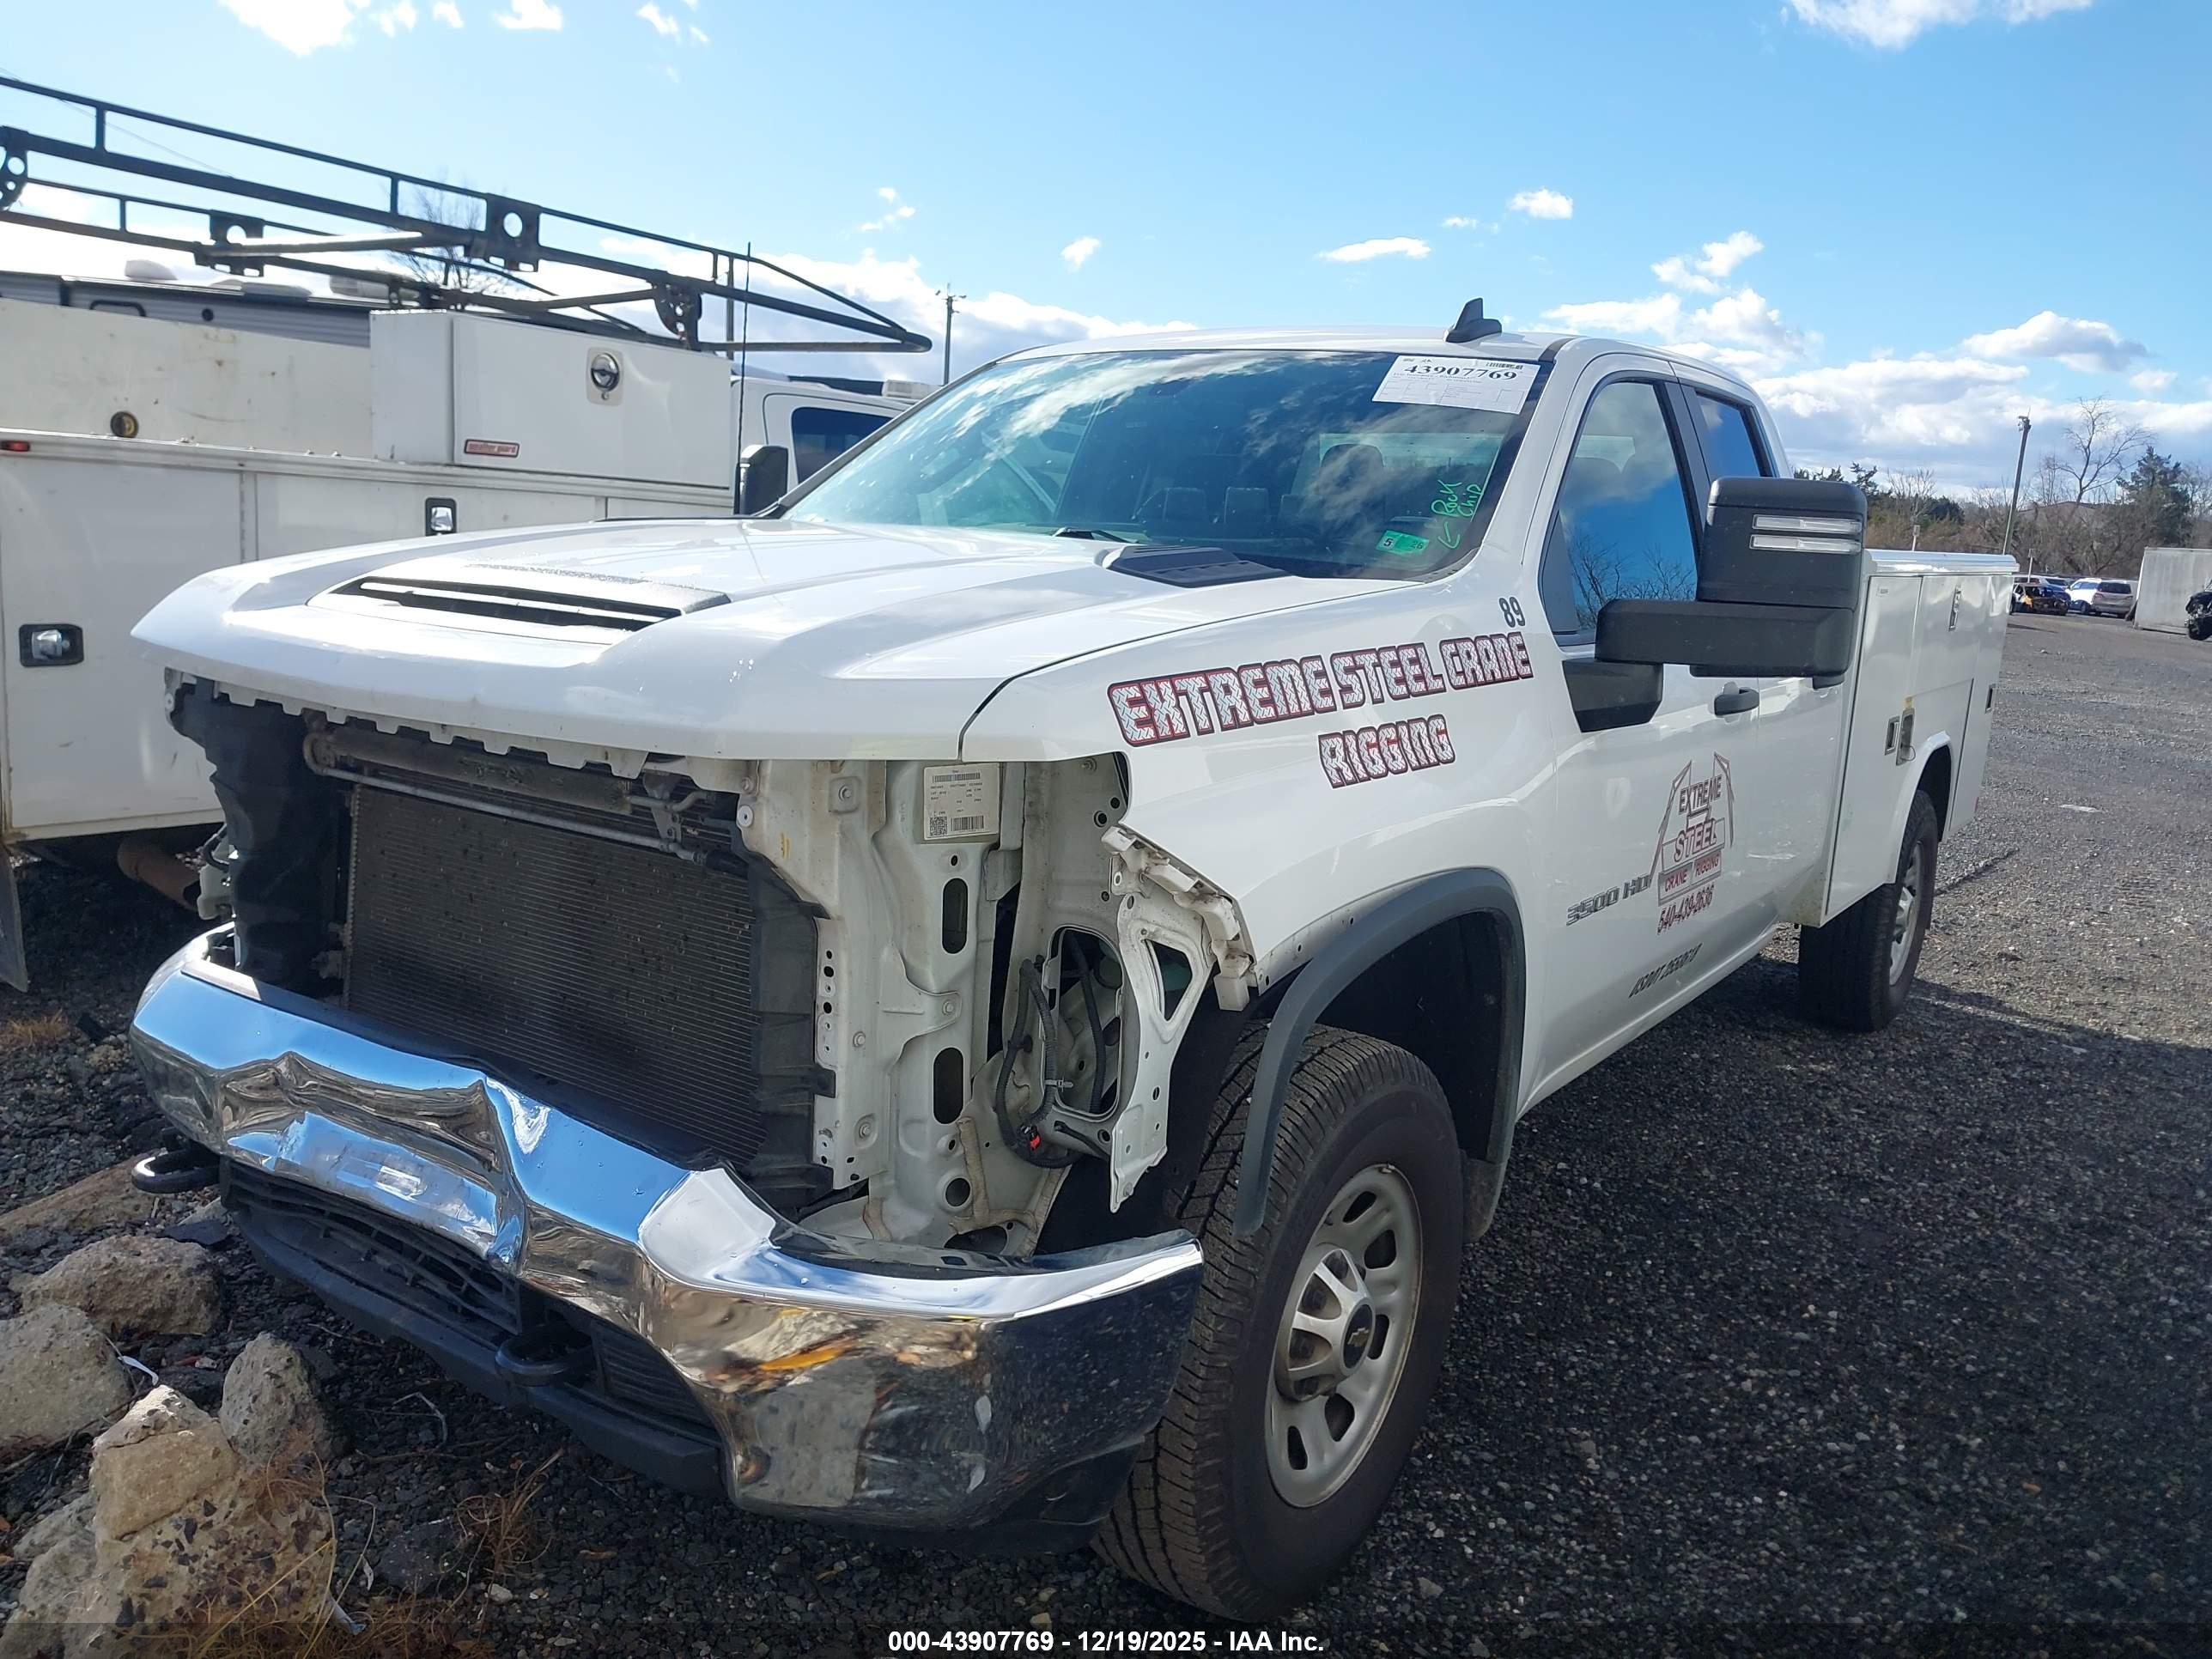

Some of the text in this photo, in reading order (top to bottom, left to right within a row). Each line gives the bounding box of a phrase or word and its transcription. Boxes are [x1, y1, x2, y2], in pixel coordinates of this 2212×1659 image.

[1404, 364, 1517, 380] 43907769
[1383, 538, 1423, 550] 5 26
[1498, 596, 1526, 628] 89
[1107, 631, 1534, 747] EXTREME STEEL CRANE
[1317, 714, 1455, 788] RIGGING
[1678, 775, 1723, 815] EXTREME
[1674, 817, 1717, 862] STEEL
[1664, 854, 1719, 892] CRANE RIGGING
[1566, 872, 1650, 927] 3500 HD
